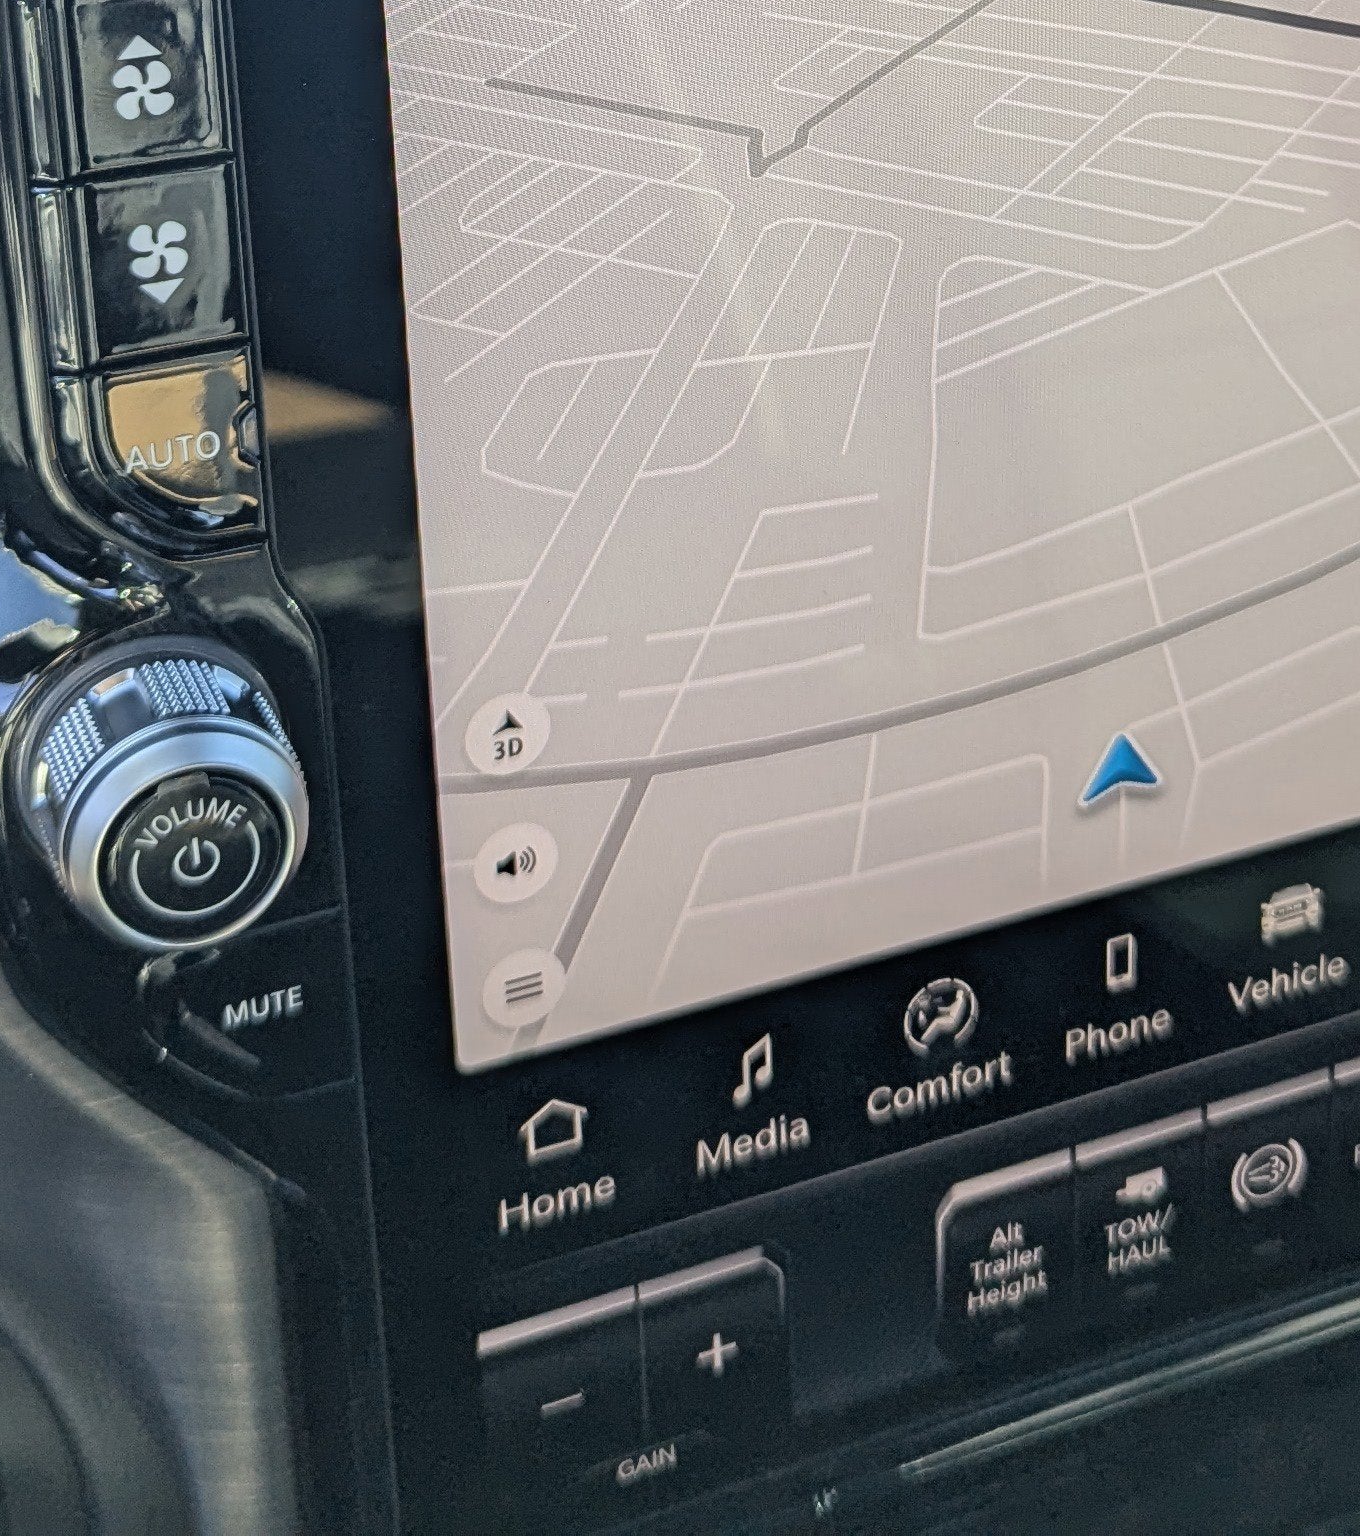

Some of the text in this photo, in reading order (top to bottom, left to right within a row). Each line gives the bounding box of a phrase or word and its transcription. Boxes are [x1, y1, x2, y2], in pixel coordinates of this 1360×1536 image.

[122, 429, 222, 474] AUTO
[493, 736, 523, 761] 3D
[136, 796, 250, 852] VOLUME
[1228, 952, 1350, 1010] Vehicle
[222, 983, 305, 1031] MUTE
[1065, 1006, 1173, 1064] Phone
[866, 1050, 1013, 1122] Comfort
[695, 1115, 812, 1176] Media
[498, 1174, 616, 1235] Home
[1104, 1202, 1175, 1246] TOW/
[989, 1220, 1025, 1250] Alt
[1106, 1236, 1172, 1274] HAUL
[969, 1244, 1044, 1284] Trailer
[966, 1268, 1049, 1316] Height
[616, 1443, 678, 1487] GAIN
